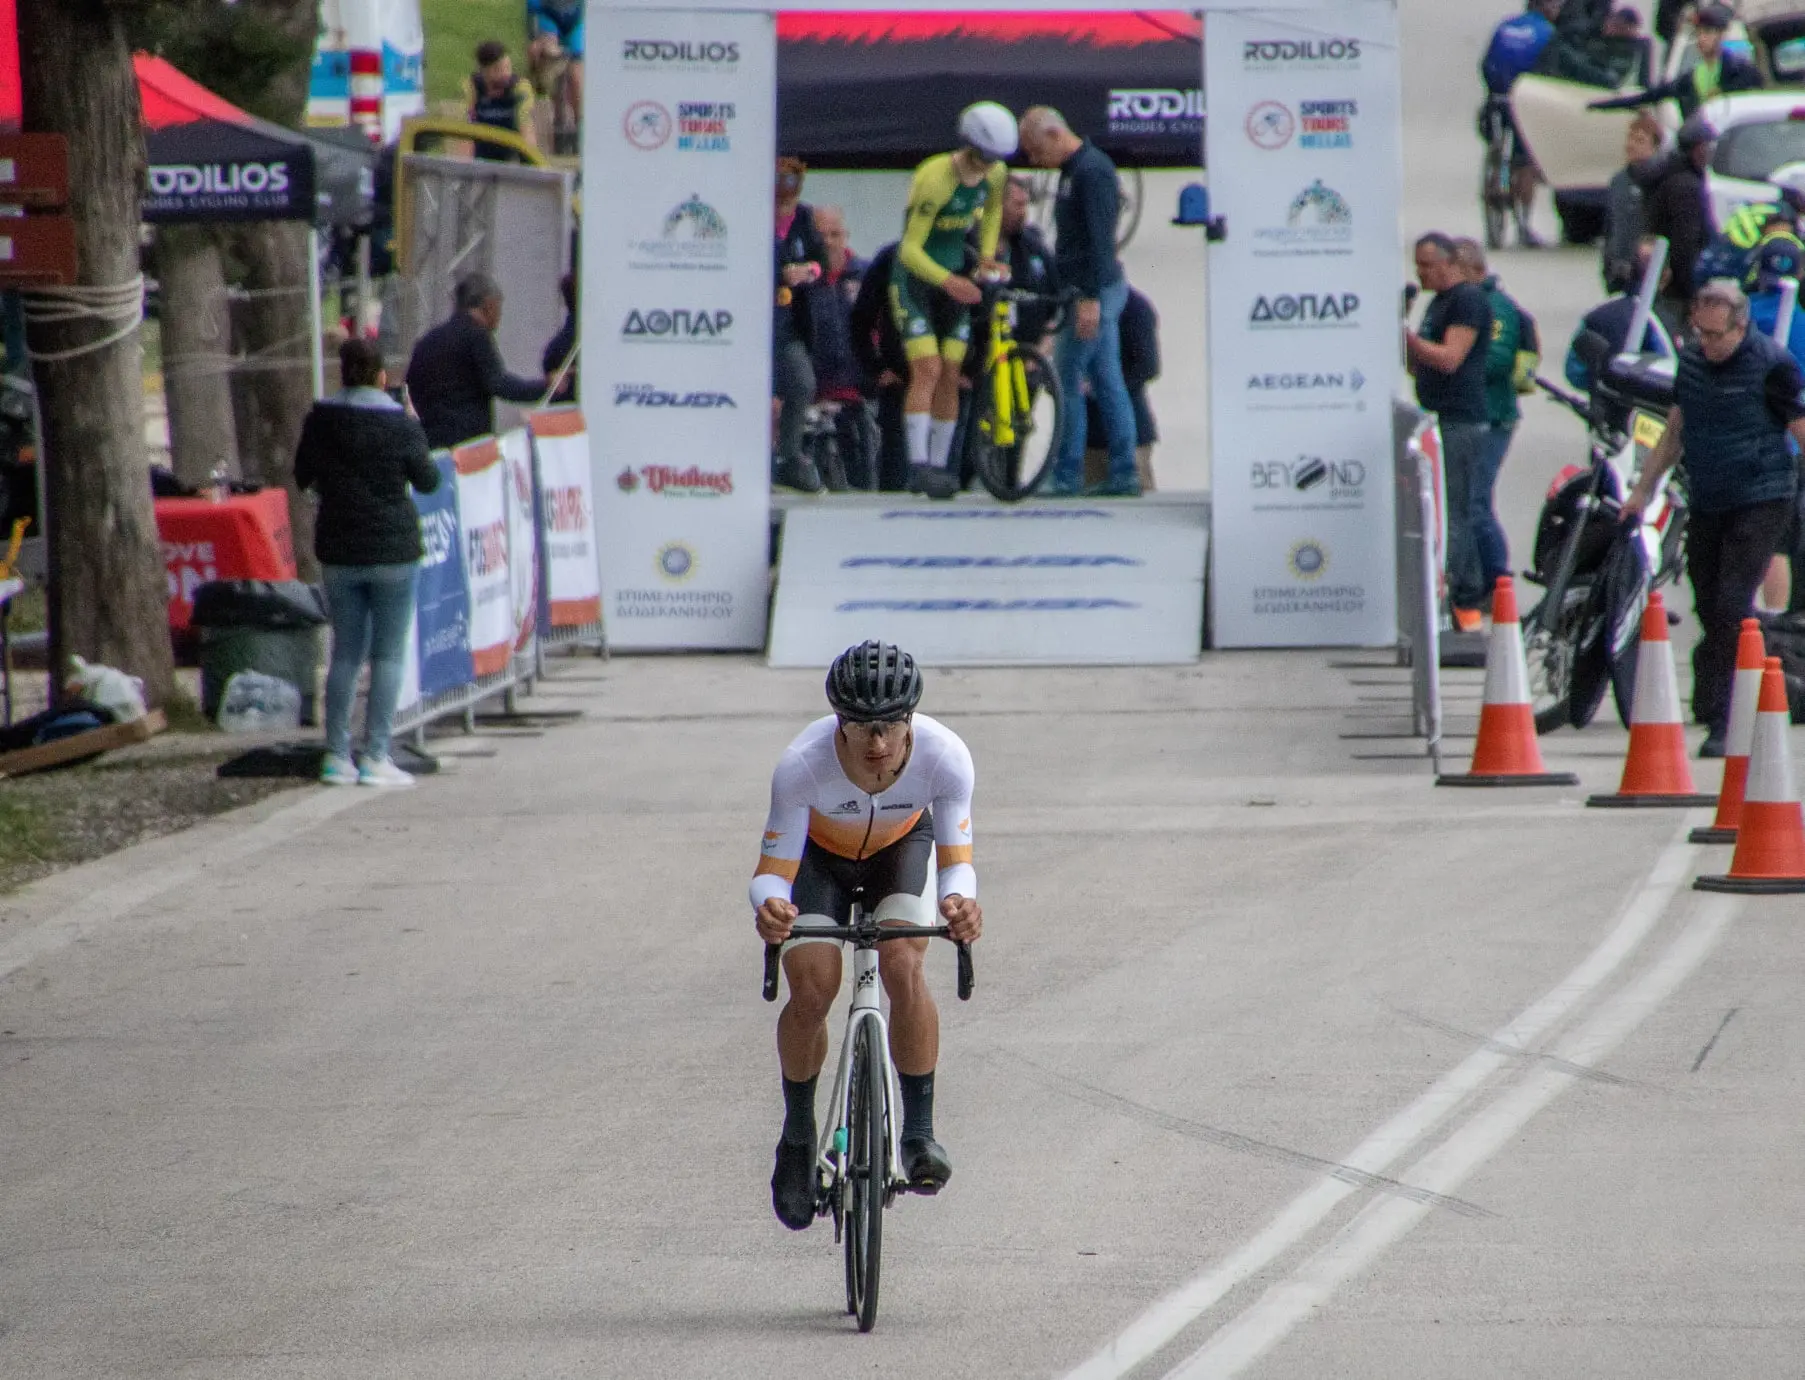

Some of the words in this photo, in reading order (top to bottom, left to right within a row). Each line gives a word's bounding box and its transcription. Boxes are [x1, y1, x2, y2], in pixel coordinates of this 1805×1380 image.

[623, 39, 740, 62] RODILIOS
[1244, 37, 1361, 61] RODILIOS
[1108, 88, 1207, 119] RODIL
[147, 161, 289, 194] ODILIOS
[1248, 372, 1345, 390] AEGEAN
